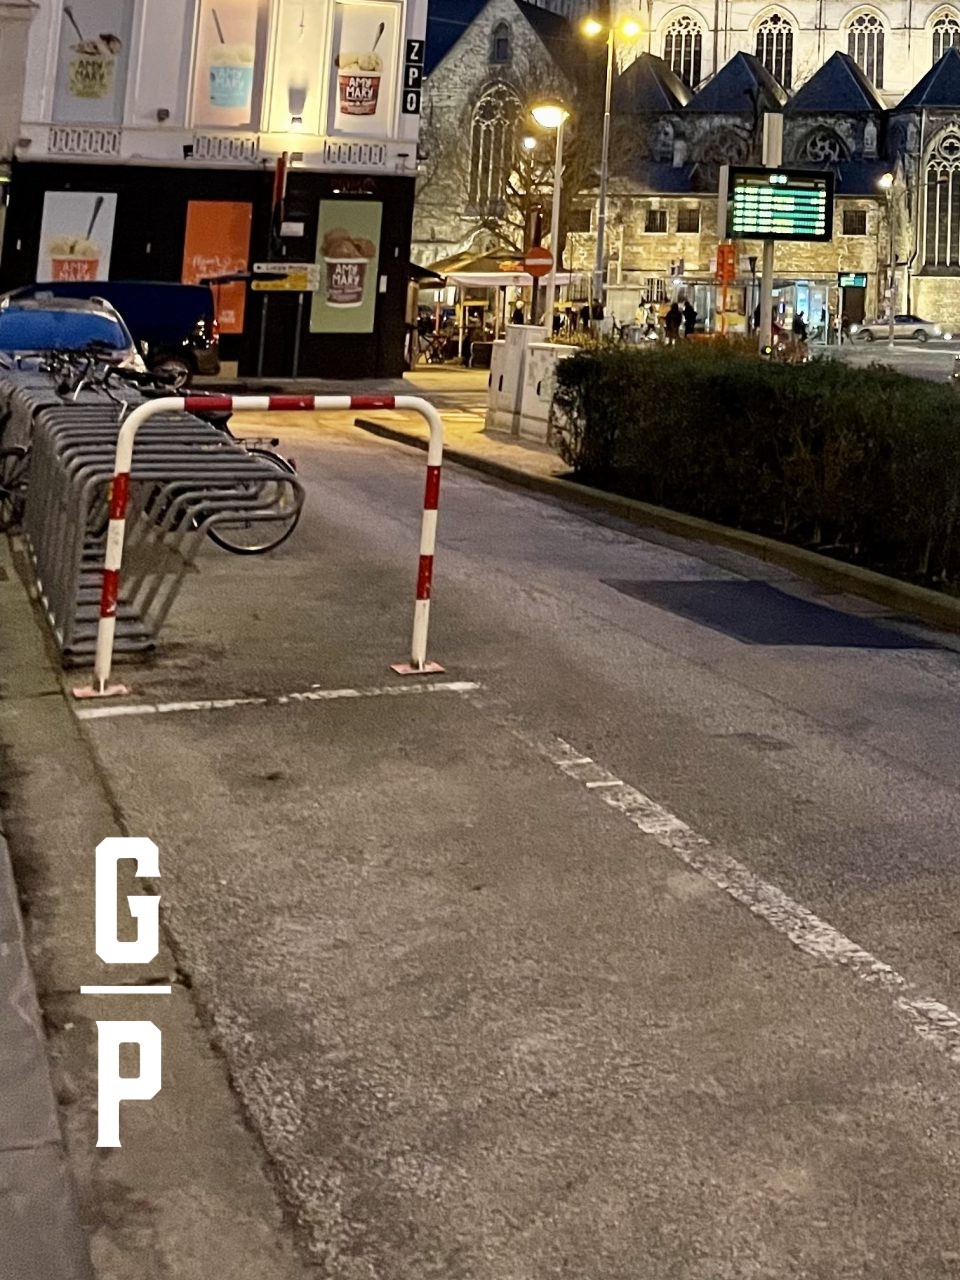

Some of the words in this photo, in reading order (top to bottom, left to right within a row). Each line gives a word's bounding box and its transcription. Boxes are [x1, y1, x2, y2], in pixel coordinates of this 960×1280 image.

[78, 60, 103, 71] AMY
[75, 70, 105, 84] MARY
[348, 77, 372, 87] AMY
[346, 85, 373, 98] MARY
[62, 261, 88, 273] AMY
[335, 263, 358, 275] AMY
[60, 271, 90, 282] MARY
[332, 273, 360, 286] MARY
